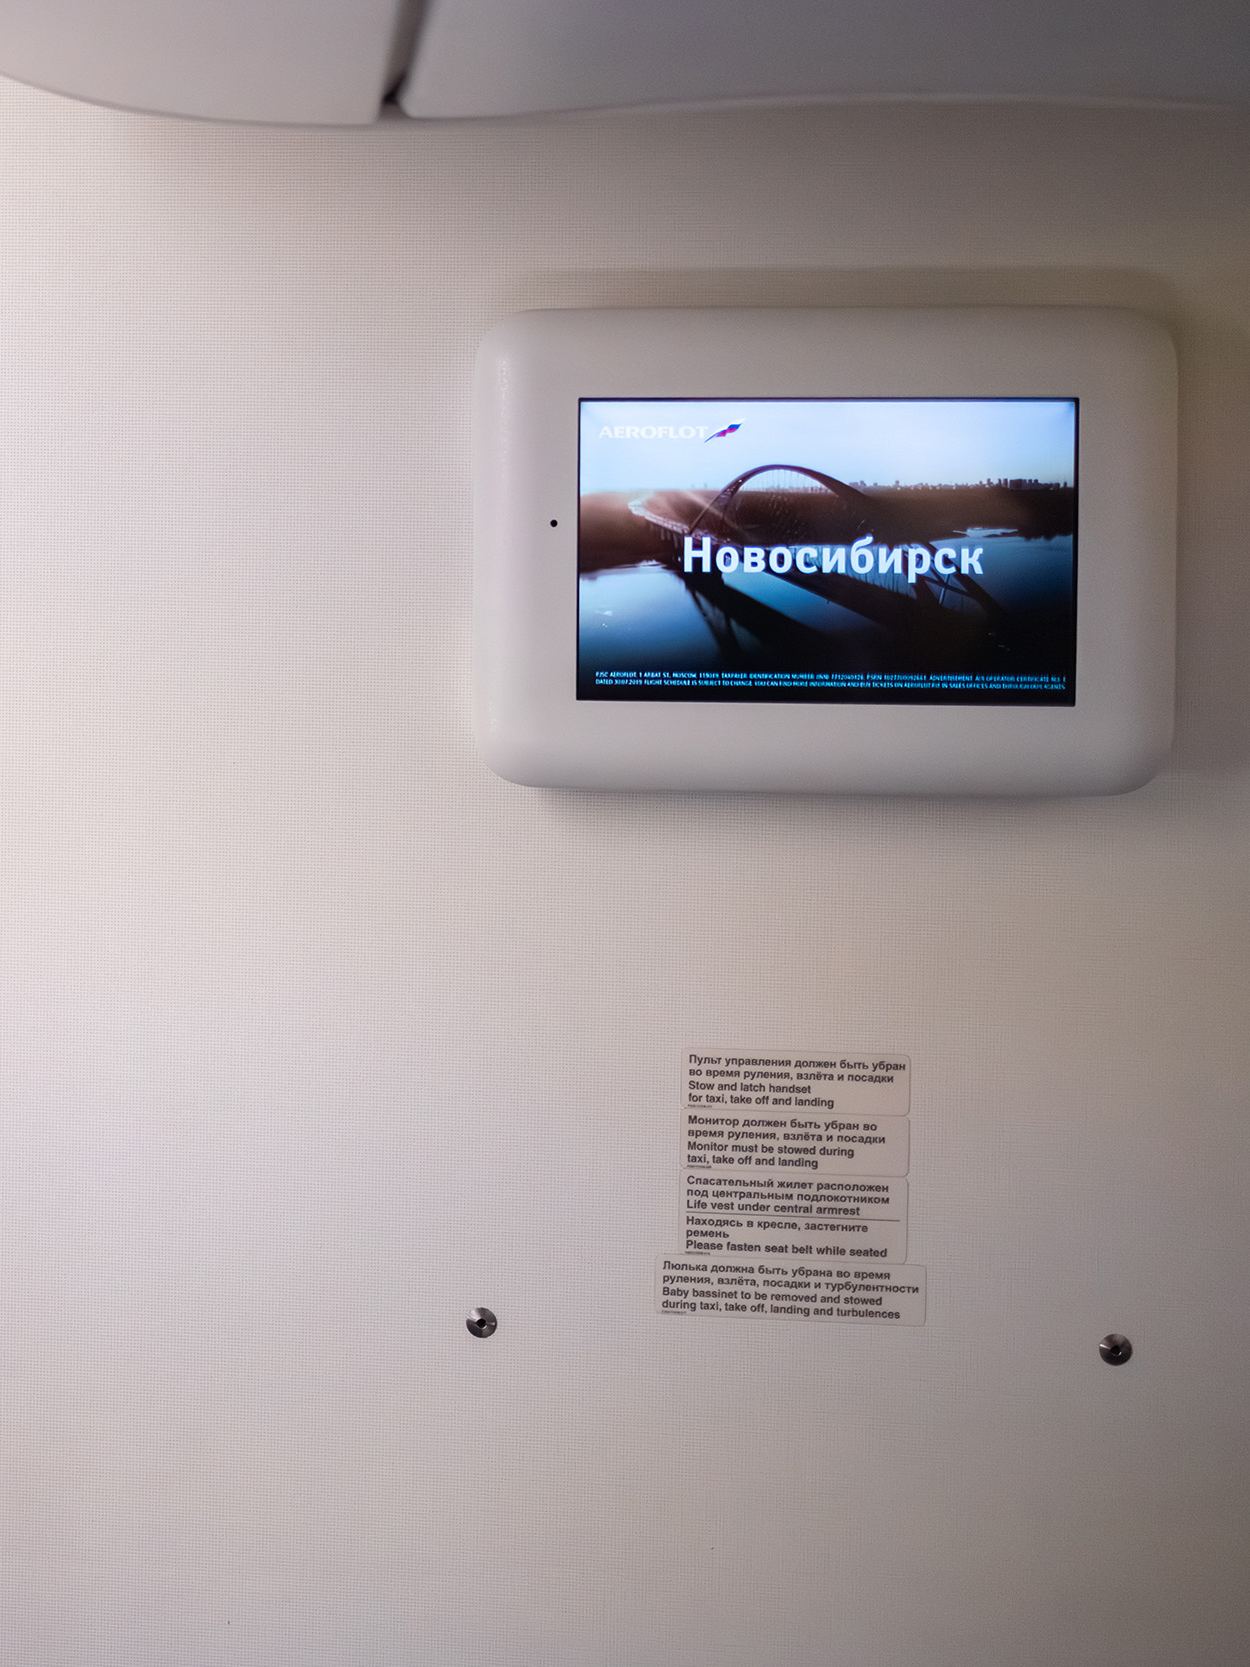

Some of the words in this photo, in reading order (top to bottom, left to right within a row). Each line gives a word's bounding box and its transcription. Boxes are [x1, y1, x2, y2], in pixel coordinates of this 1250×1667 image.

[598, 425, 710, 439] AEROFLOT
[683, 534, 983, 583] Новосибирск
[689, 1054, 722, 1067] Пульт
[725, 1058, 791, 1068] управления
[794, 1060, 836, 1069] должен
[840, 1059, 869, 1069] быть
[872, 1061, 906, 1072] убран
[706, 1070, 740, 1078] время
[744, 1071, 793, 1080] руления,
[797, 1071, 834, 1081] взлёта
[848, 1074, 893, 1083] посадки
[689, 1080, 714, 1090] Stow
[718, 1082, 737, 1091] and
[741, 1082, 765, 1092] latch
[769, 1084, 811, 1094] handset
[689, 1093, 702, 1102] for
[706, 1094, 727, 1104] taxi,
[730, 1095, 752, 1104] take
[755, 1096, 769, 1104] off
[772, 1097, 791, 1105] and
[795, 1097, 834, 1109] landing
[688, 1115, 739, 1128] Монитор
[742, 1119, 787, 1127] должен
[790, 1119, 820, 1129] быть
[824, 1120, 859, 1132] убран
[688, 1130, 724, 1139] время
[728, 1131, 779, 1140] руления,
[783, 1132, 822, 1141] взлёта
[837, 1135, 885, 1145] посадки
[688, 1141, 728, 1151] Monitor
[732, 1144, 758, 1153] must
[761, 1144, 774, 1153] be
[778, 1145, 816, 1155] stowed
[819, 1147, 854, 1159] during
[687, 1154, 709, 1164] taxi,
[712, 1155, 734, 1164] take
[738, 1156, 752, 1165] off
[755, 1157, 775, 1166] and
[778, 1157, 818, 1170] landing
[687, 1175, 774, 1187] Спасательный
[777, 1181, 813, 1189] жилет
[817, 1183, 889, 1192] расположен
[687, 1189, 708, 1198] под
[712, 1190, 793, 1200] центральным
[797, 1193, 890, 1205] подлокотником
[687, 1200, 707, 1209] Life
[711, 1202, 734, 1210] vest
[738, 1202, 770, 1211] under
[774, 1204, 812, 1213] central
[816, 1207, 860, 1216] armrest
[686, 1216, 743, 1227] Находясь
[757, 1221, 800, 1231] кресле,
[805, 1223, 868, 1232] застегните
[686, 1230, 729, 1239] ремень
[686, 1240, 723, 1250] Please
[727, 1242, 761, 1252] fasten
[765, 1245, 788, 1253] seat
[792, 1244, 813, 1254] belt
[816, 1246, 846, 1256] while
[849, 1248, 887, 1257] seated
[663, 1261, 707, 1271] Люлька
[710, 1265, 754, 1274] должна
[758, 1265, 788, 1275] быть
[792, 1267, 832, 1278] убрана
[854, 1272, 890, 1281] время
[663, 1275, 713, 1285] руления,
[718, 1276, 759, 1287] взлёта,
[763, 1280, 810, 1289] посадки
[825, 1281, 919, 1294] турбулентности
[663, 1287, 689, 1300] Baby
[693, 1288, 737, 1299] bassinet
[741, 1291, 751, 1299] to
[755, 1291, 767, 1300] be
[771, 1294, 817, 1302] removed
[821, 1295, 840, 1303] and
[844, 1296, 882, 1306] stowed
[662, 1299, 696, 1312] during
[700, 1301, 722, 1312] taxi,
[725, 1303, 747, 1312] take
[750, 1303, 767, 1314] off,
[771, 1304, 810, 1317] landing
[813, 1307, 833, 1316] and
[837, 1308, 900, 1319] turbulences
